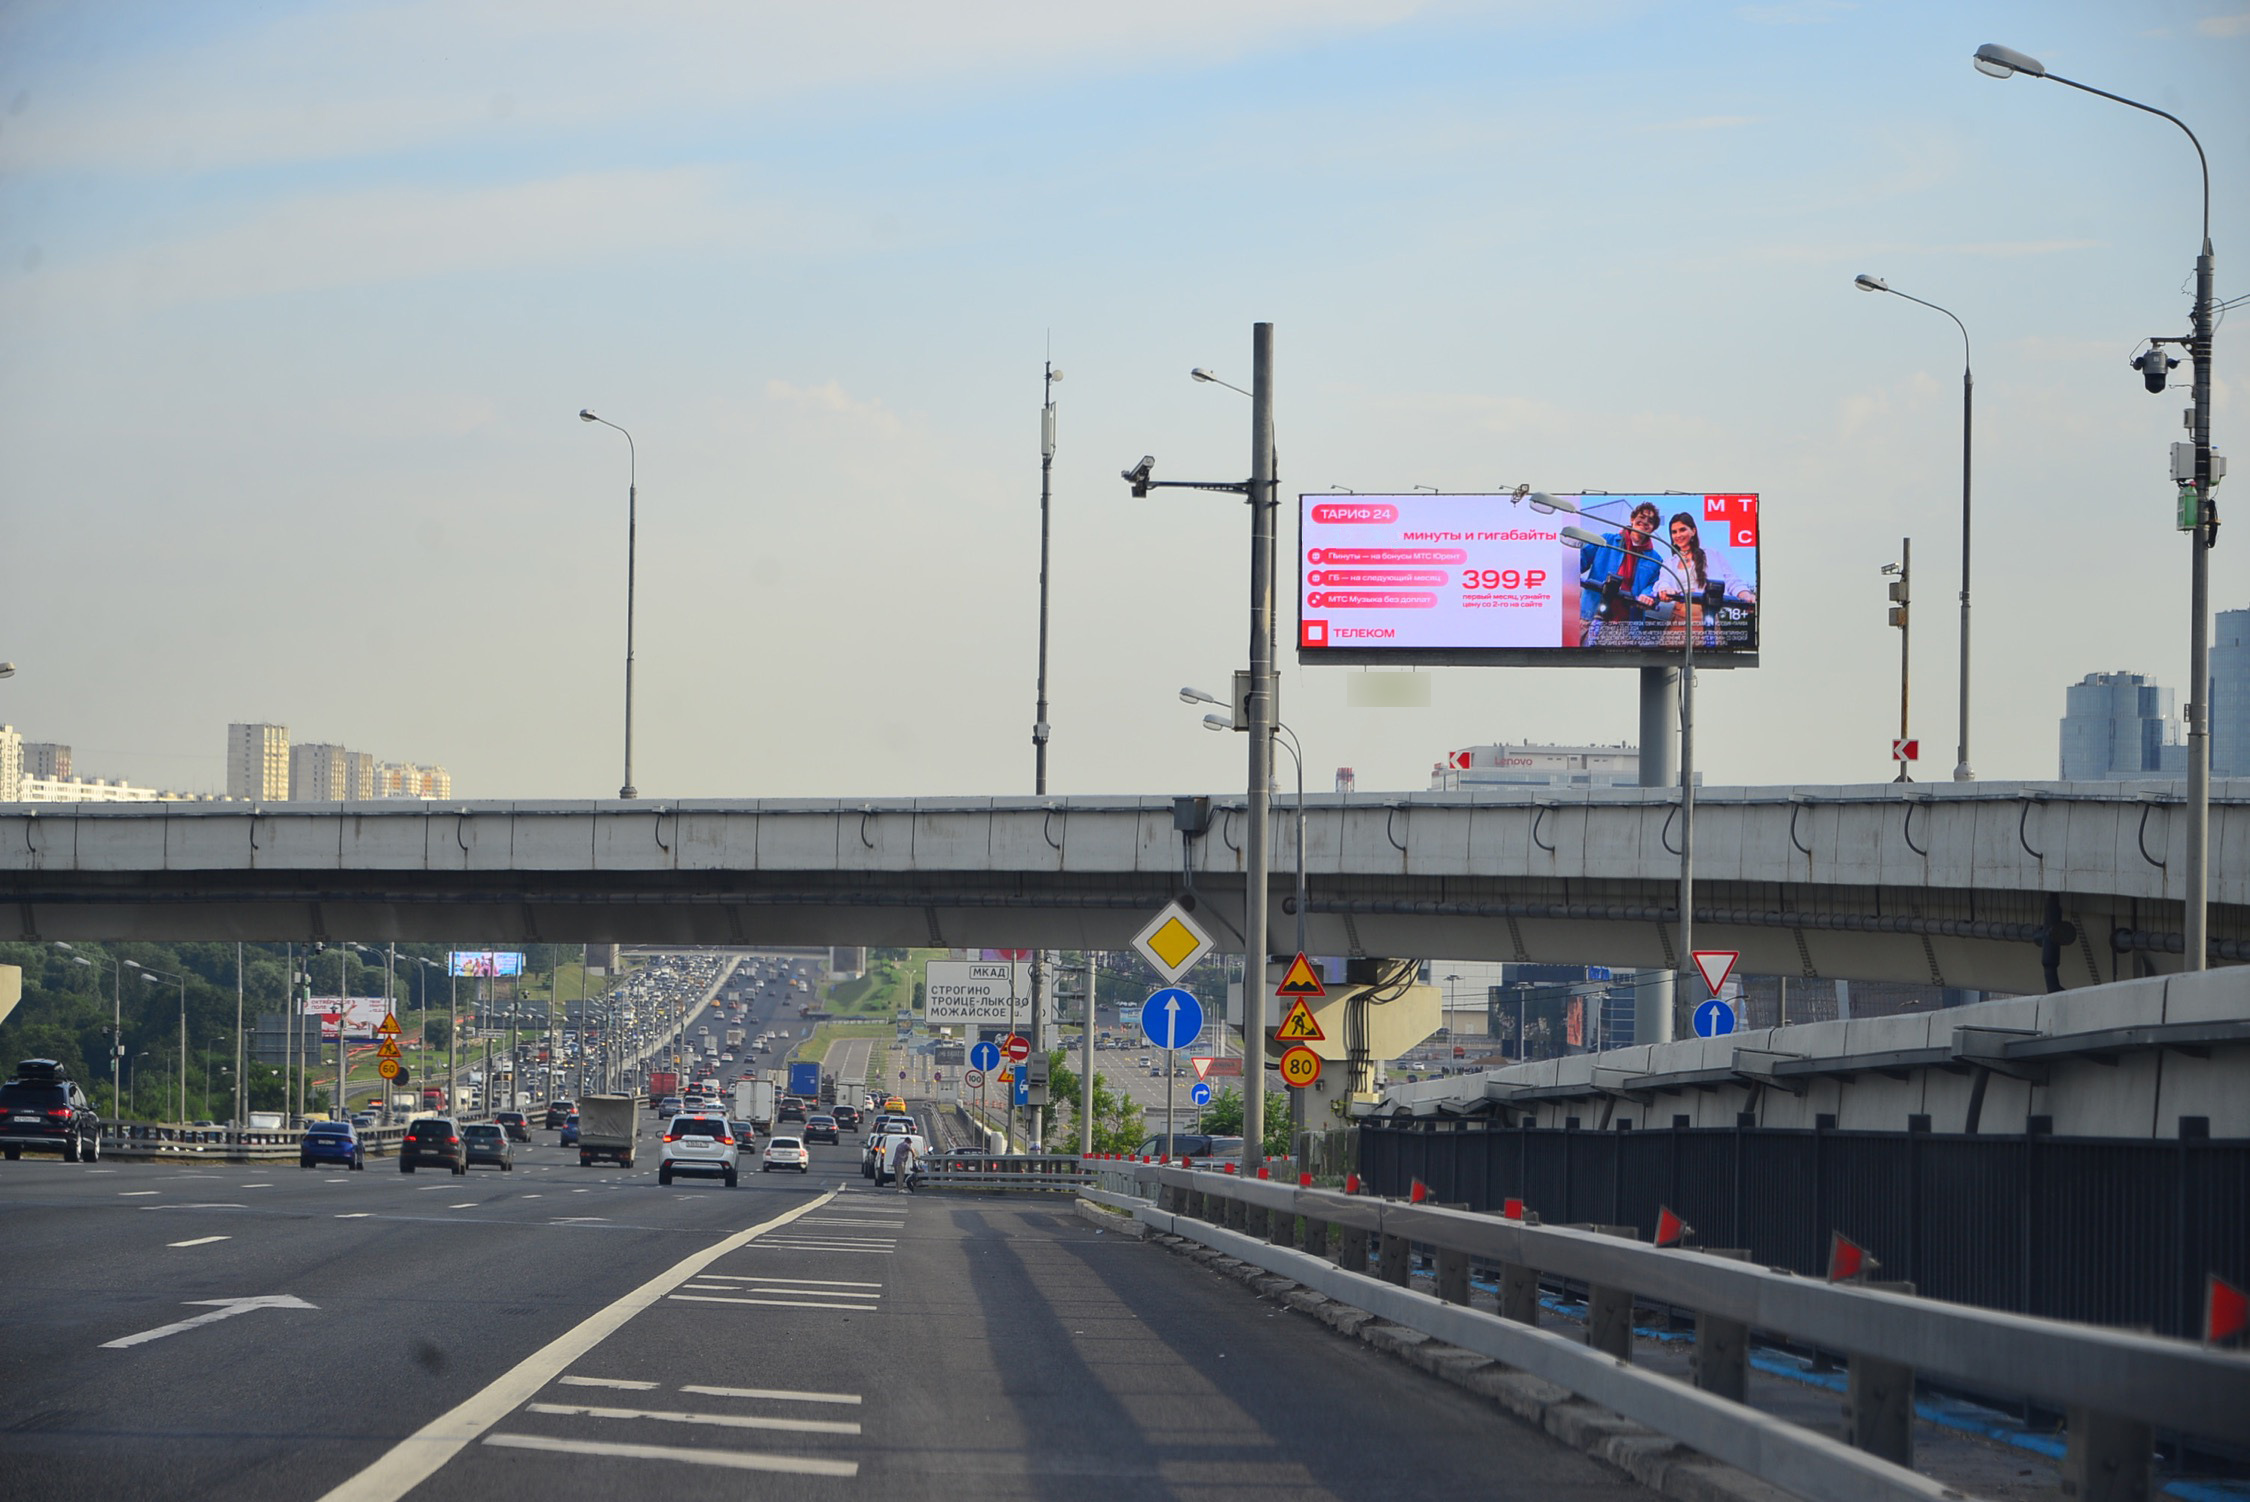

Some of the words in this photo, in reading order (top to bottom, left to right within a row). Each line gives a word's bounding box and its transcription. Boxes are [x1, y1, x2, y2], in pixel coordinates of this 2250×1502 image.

[1320, 508, 1371, 519] ТАРИФ
[1372, 508, 1391, 519] 24
[1403, 531, 1461, 543] минуты
[1465, 531, 1474, 541] и
[1477, 529, 1557, 541] гигабайты
[1382, 551, 1412, 562] бонусы
[1414, 552, 1431, 560] МТС
[1362, 573, 1412, 583] следующий
[1413, 575, 1441, 583] месяц
[1462, 569, 1520, 590] 399
[1349, 596, 1382, 604] Музыка
[1384, 595, 1399, 603] без
[1401, 596, 1431, 604] доплат
[1462, 593, 1492, 602] первый
[1519, 593, 1551, 602] узнайте
[1462, 601, 1481, 609] цену
[1521, 600, 1543, 608] сайте
[1728, 608, 1749, 620] 18+
[1333, 628, 1395, 638] ТЕЛЕКОМ
[1495, 756, 1532, 765] Lenovo
[973, 968, 1006, 978] МКАД
[931, 985, 991, 996] СТРОГИНО
[930, 1005, 1006, 1017] МОЖАЙСКОЕ
[383, 1064, 395, 1073] 60
[1290, 1059, 1312, 1074] 80
[968, 1075, 982, 1083] 100
